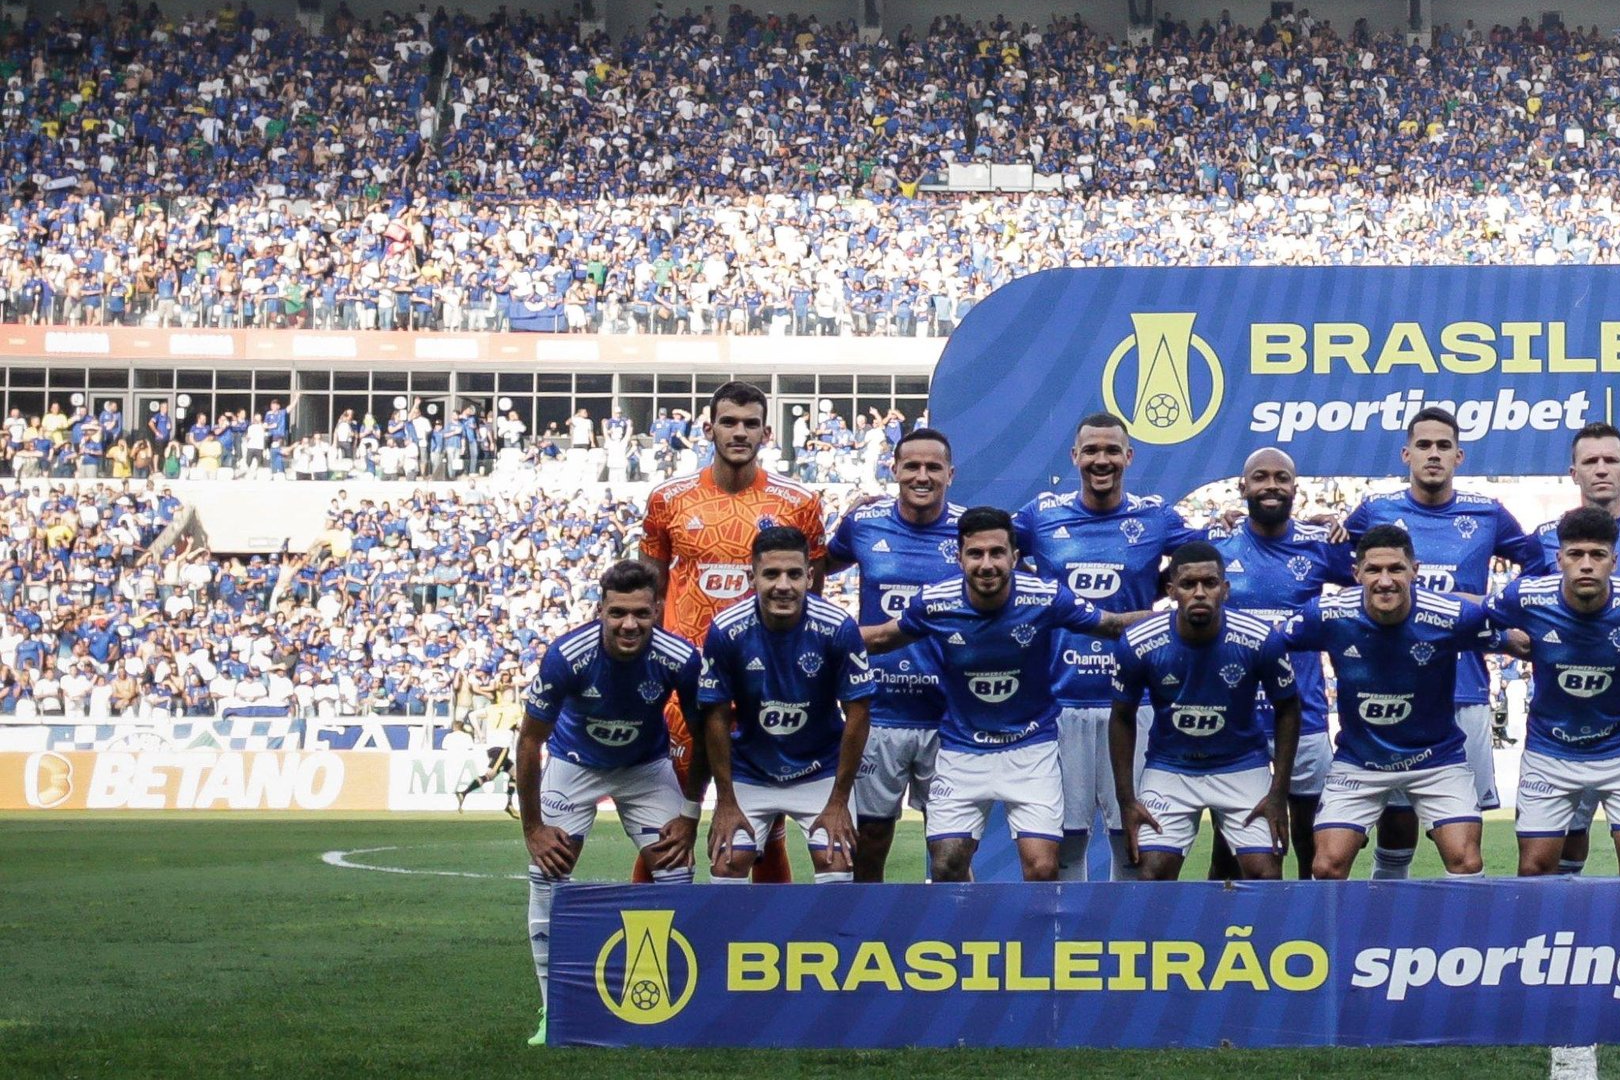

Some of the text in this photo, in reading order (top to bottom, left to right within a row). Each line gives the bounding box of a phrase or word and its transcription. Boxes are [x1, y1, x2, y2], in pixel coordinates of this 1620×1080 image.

[854, 508, 893, 522] pixbet
[706, 574, 744, 591] BH
[1075, 574, 1115, 591] BH
[1520, 595, 1558, 607] pixbet
[1415, 612, 1453, 629] pixbet
[1135, 633, 1171, 659] pixbet
[1225, 632, 1261, 651] pixbet
[974, 679, 1012, 696] BH
[1564, 675, 1607, 690] BH
[763, 711, 801, 727] BH
[1366, 703, 1406, 719] BH
[1178, 714, 1219, 730] BH
[87, 751, 344, 809] BETANO
[727, 926, 1329, 992] BRASILEIRÃO
